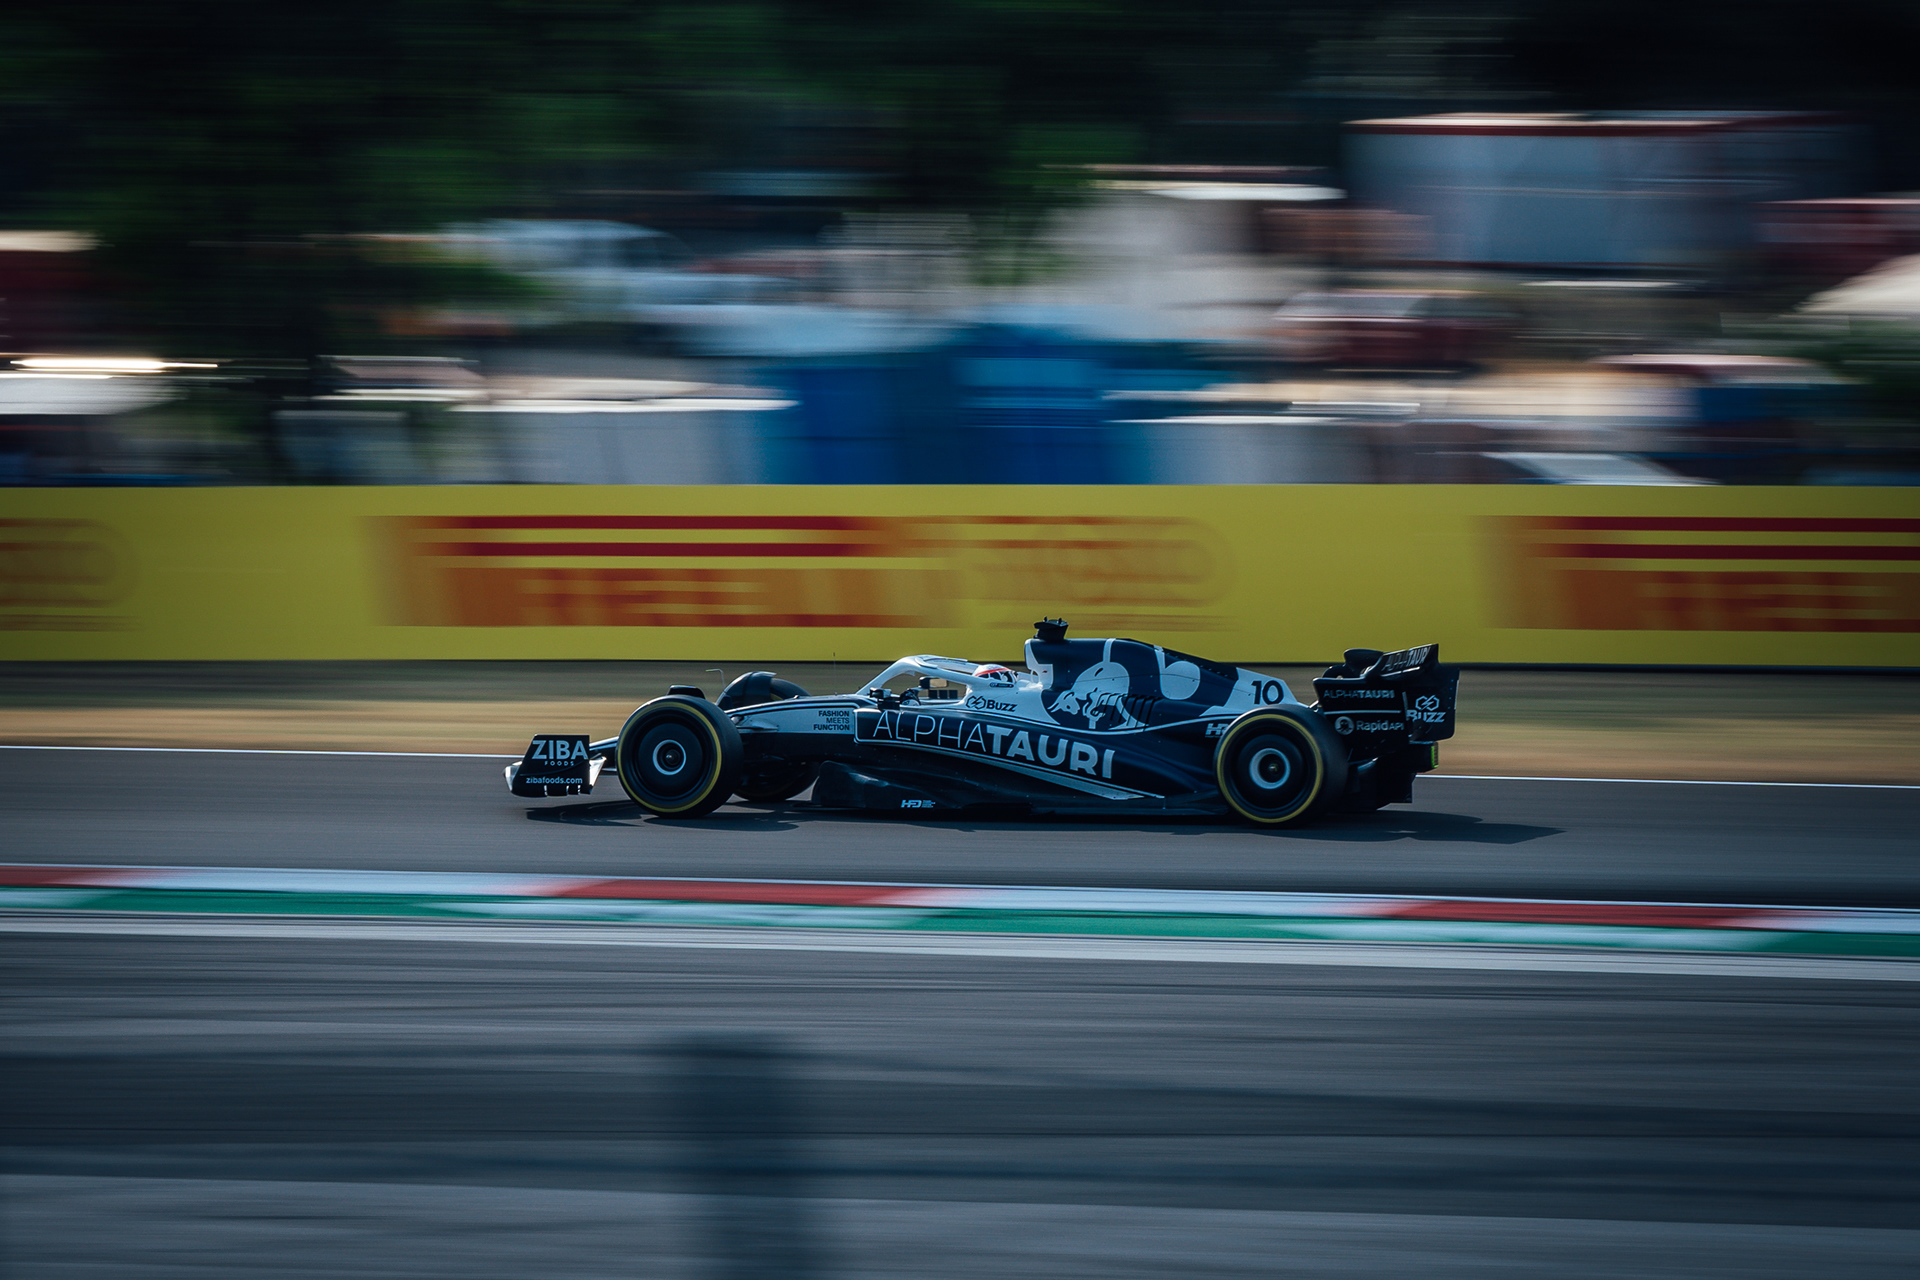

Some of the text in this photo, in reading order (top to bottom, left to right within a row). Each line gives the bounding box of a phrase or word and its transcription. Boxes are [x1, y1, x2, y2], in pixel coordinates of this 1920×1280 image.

[1251, 680, 1284, 705] 10
[1323, 690, 1395, 699] ALPHATAURI
[531, 740, 589, 760] ZIBA
[873, 710, 1115, 779] ALPHATAURI
[526, 776, 583, 784] zibafoods.com
